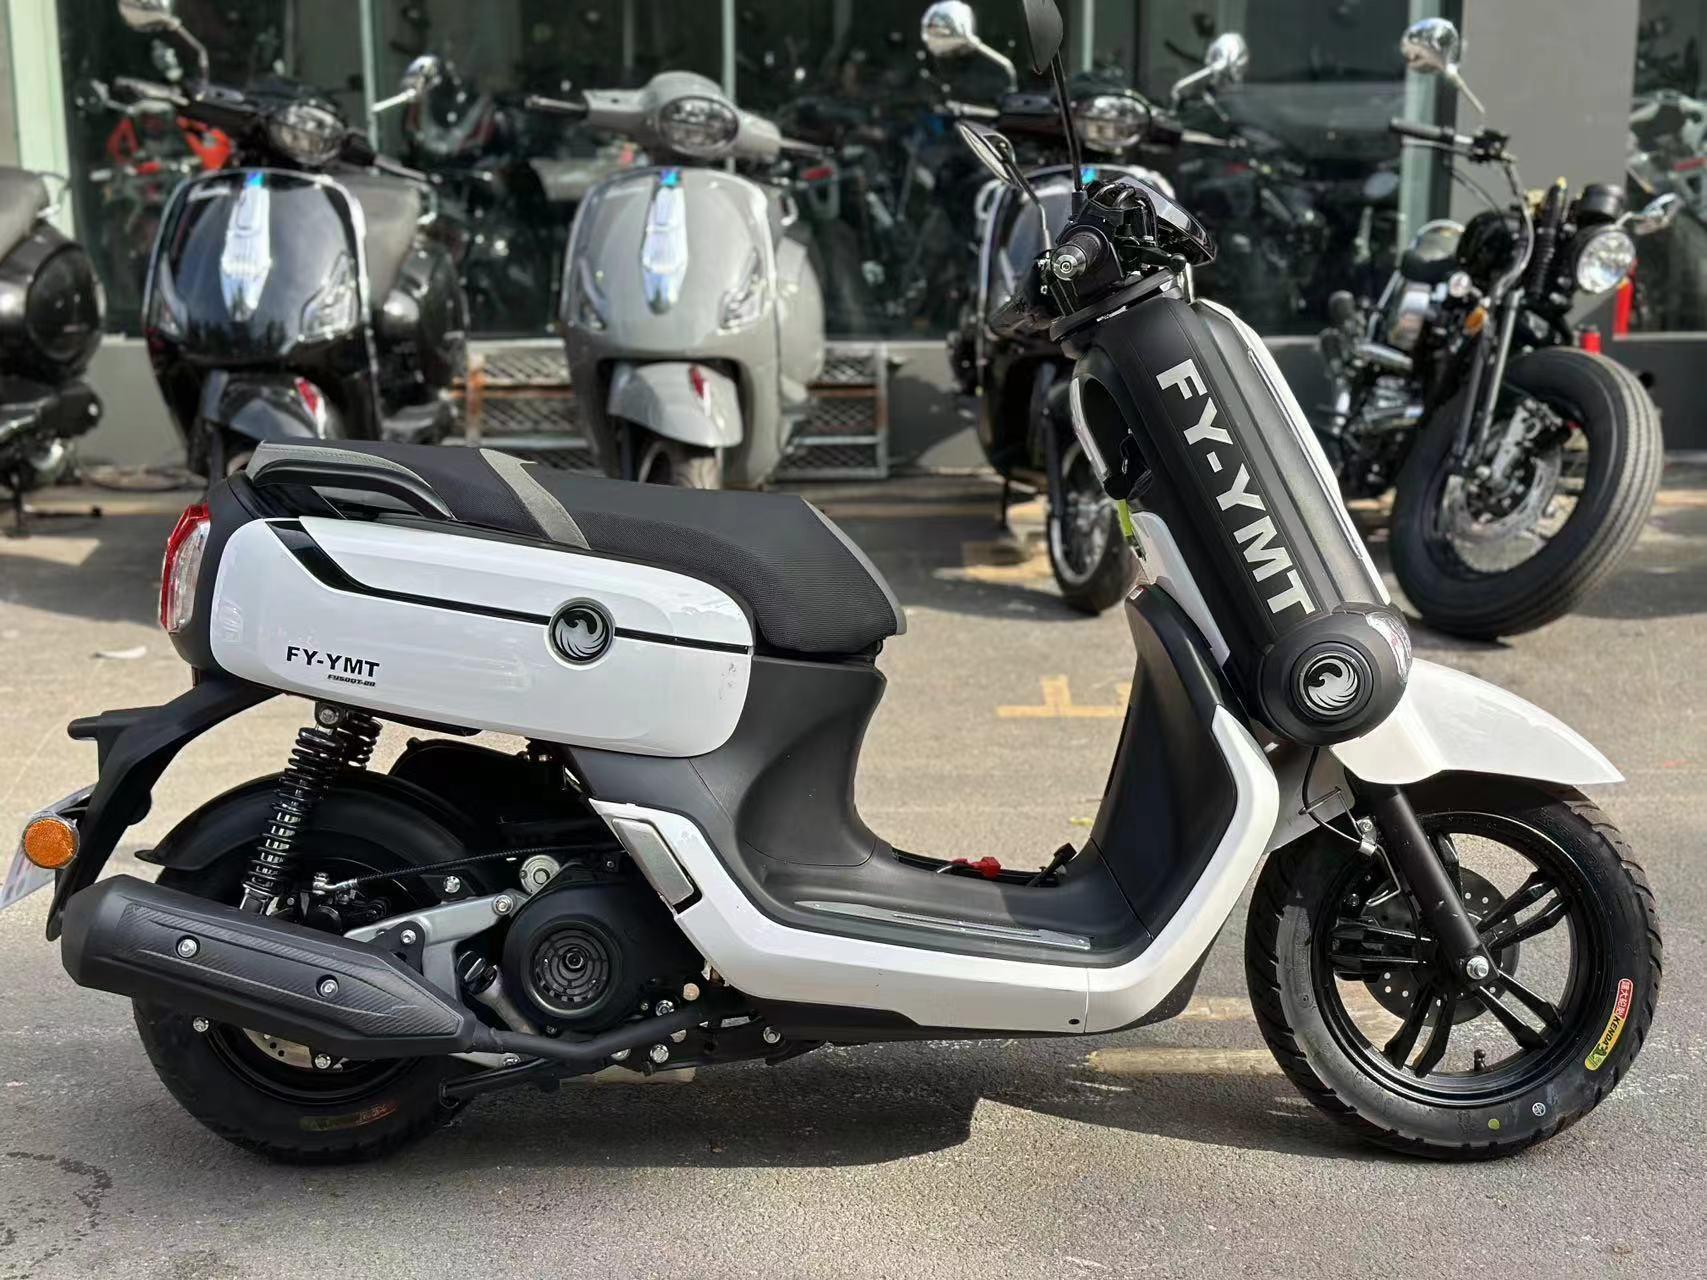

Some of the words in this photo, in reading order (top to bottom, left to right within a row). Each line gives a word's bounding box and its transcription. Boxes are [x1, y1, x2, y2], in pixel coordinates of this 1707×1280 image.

[1156, 359, 1316, 614] FY-YMT
[286, 646, 380, 677] FY-YMT
[1601, 1015, 1620, 1046] KENDA
